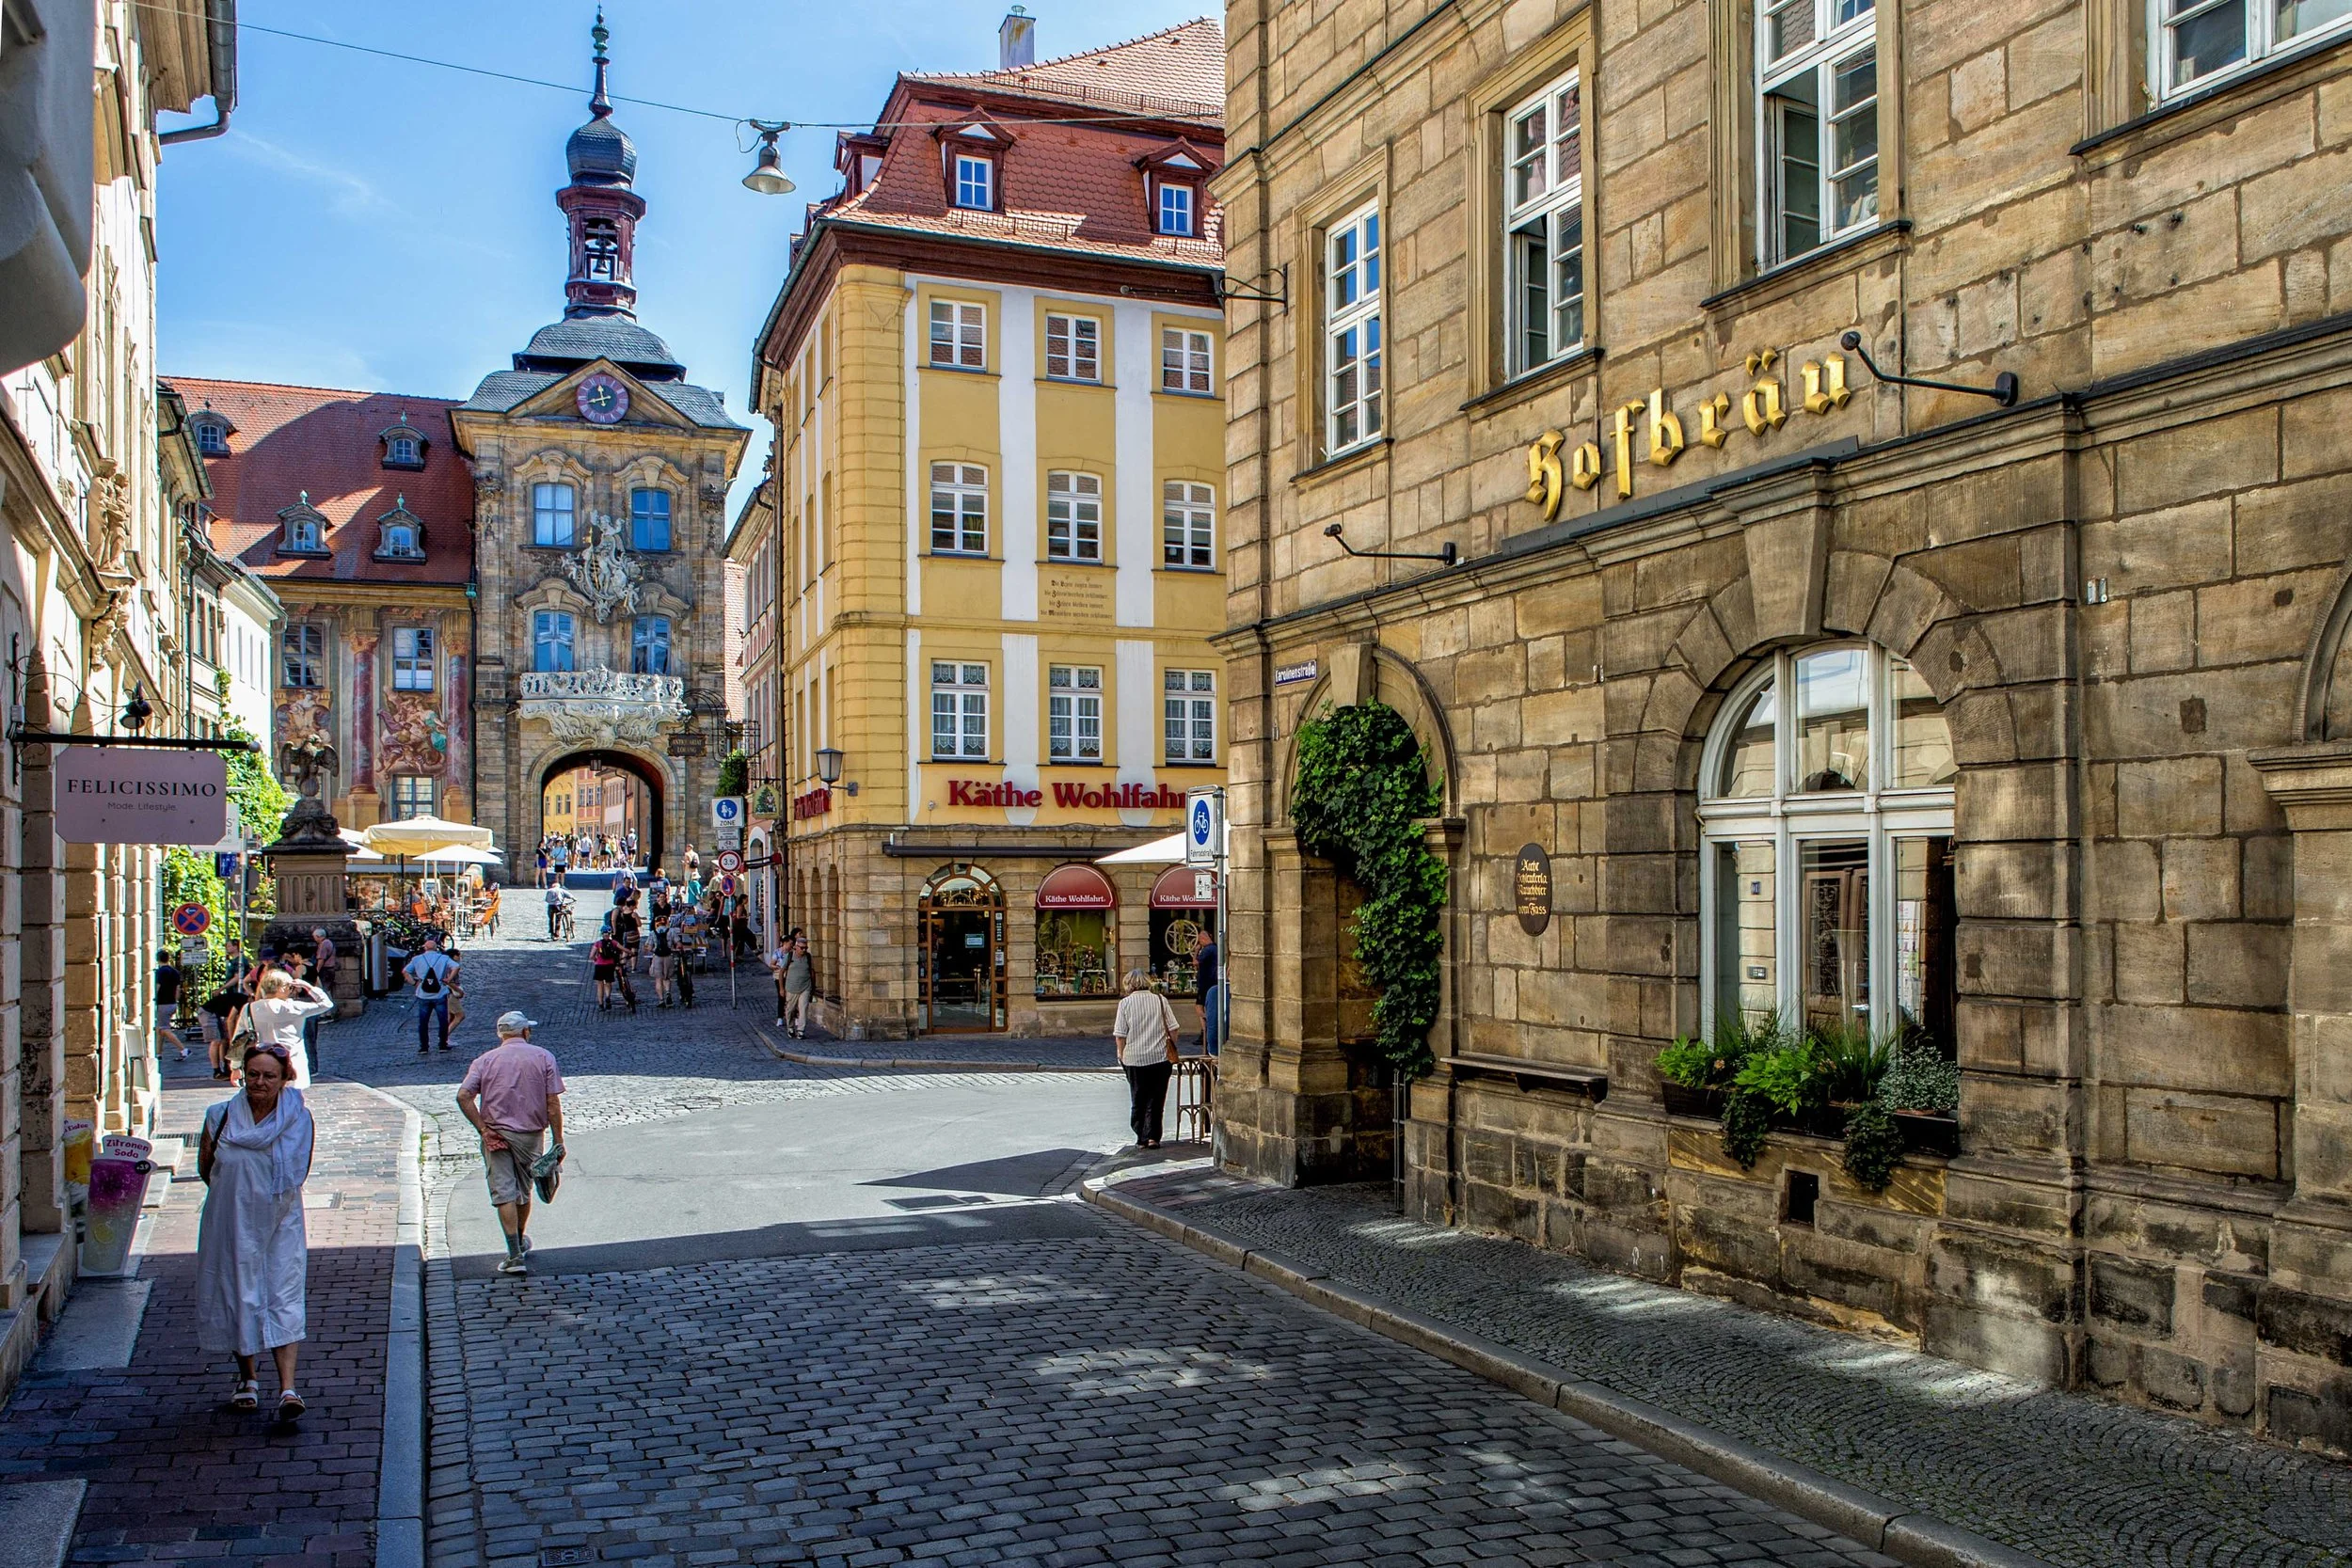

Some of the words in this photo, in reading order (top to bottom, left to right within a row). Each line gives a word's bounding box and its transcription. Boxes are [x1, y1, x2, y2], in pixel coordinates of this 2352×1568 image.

[1524, 347, 1851, 523] Hofbräu
[67, 779, 217, 798] FELICISSIMO
[947, 780, 1043, 807] Käthe
[1051, 782, 1186, 809] Wohlfahr
[107, 801, 135, 811] Mode.
[137, 802, 179, 813] Lifestyle.
[1045, 895, 1067, 903] Käthe
[1160, 895, 1181, 903] Käthe
[105, 1139, 150, 1152] Zitronen
[114, 1148, 139, 1159] Soda
